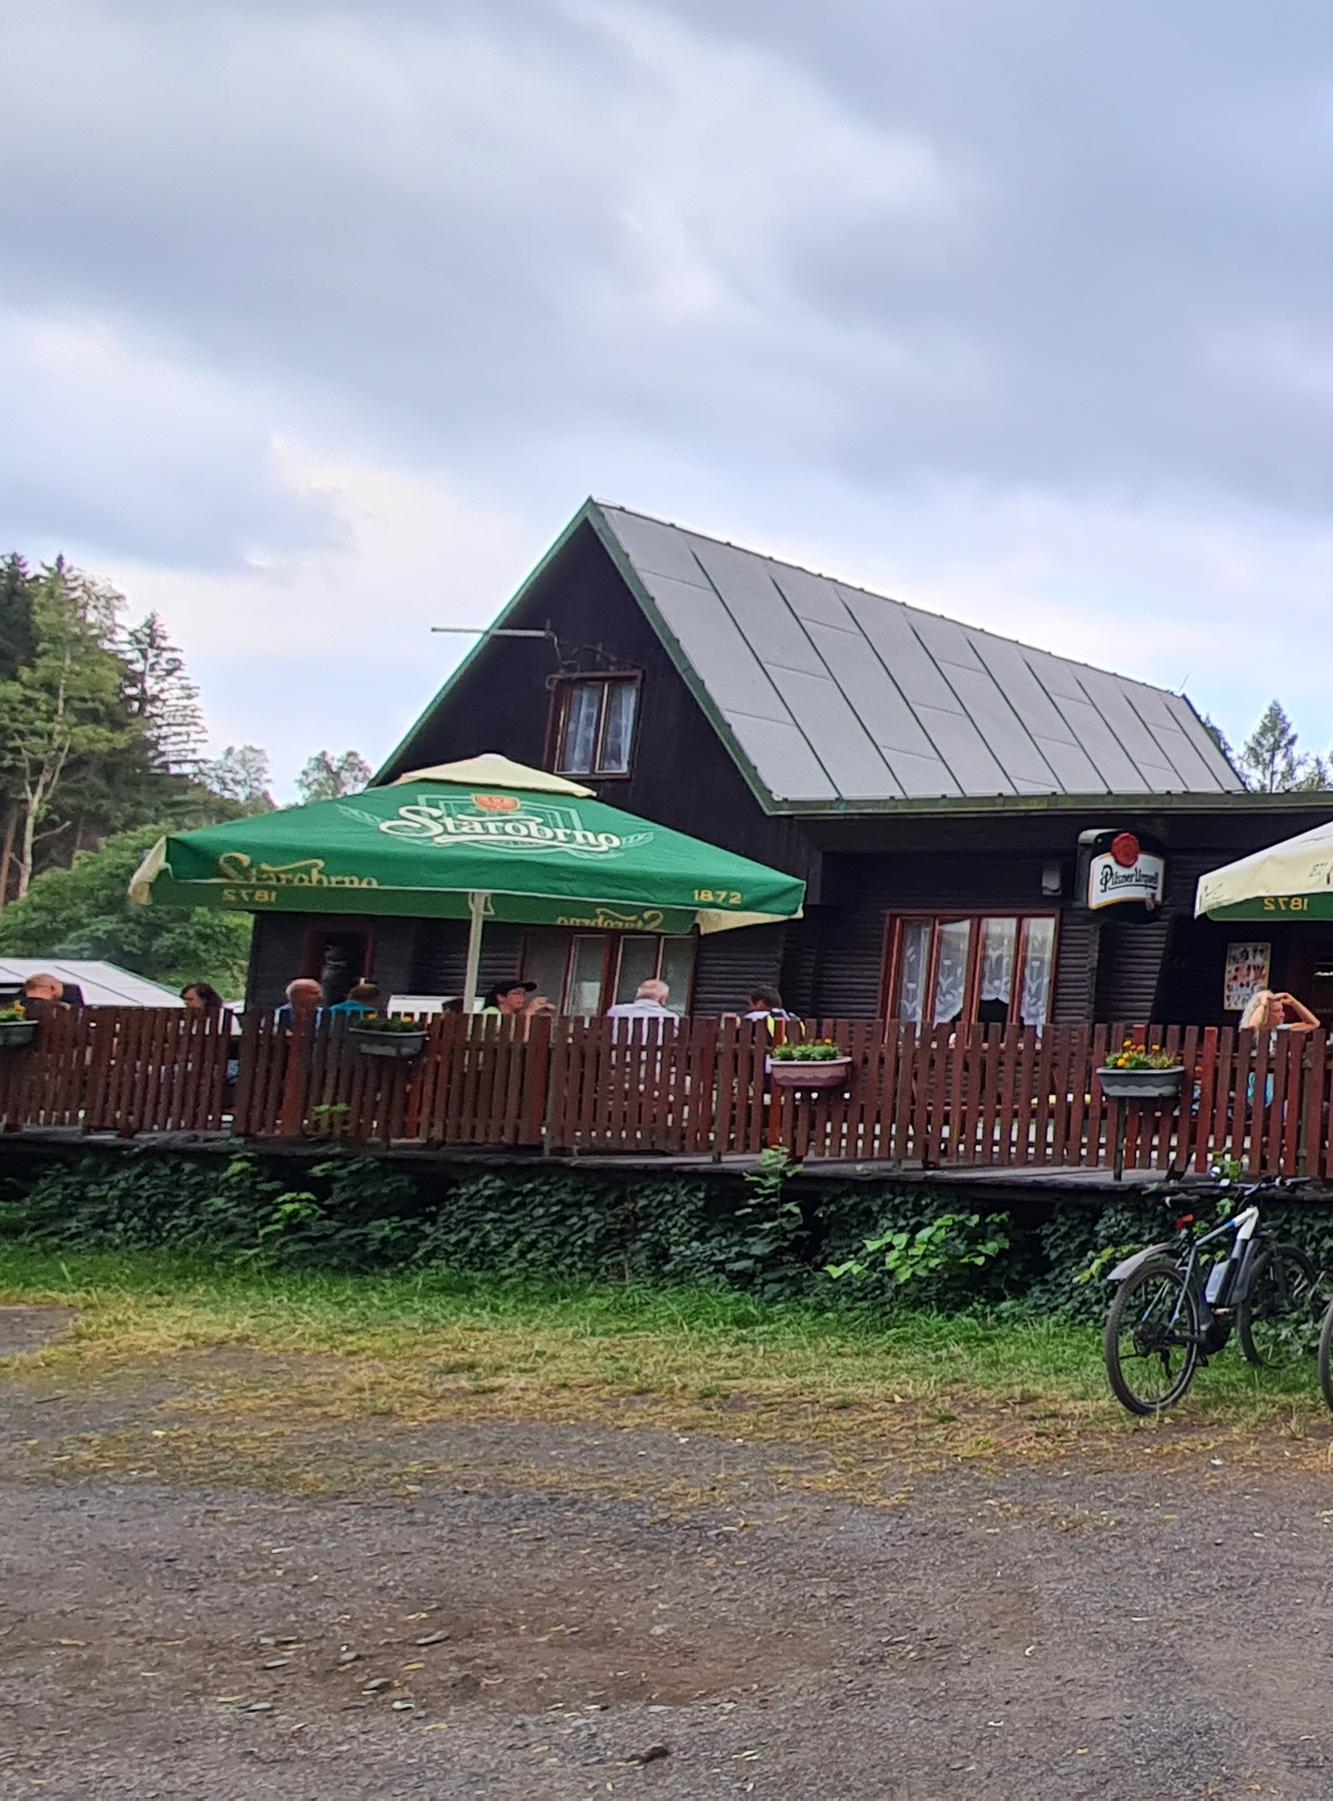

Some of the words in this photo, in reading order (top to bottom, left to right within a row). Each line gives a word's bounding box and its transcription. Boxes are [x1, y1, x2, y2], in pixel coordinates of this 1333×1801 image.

[379, 805, 621, 852] Starobrno
[1100, 864, 1135, 893] Pilsner
[693, 889, 742, 904] 1872
